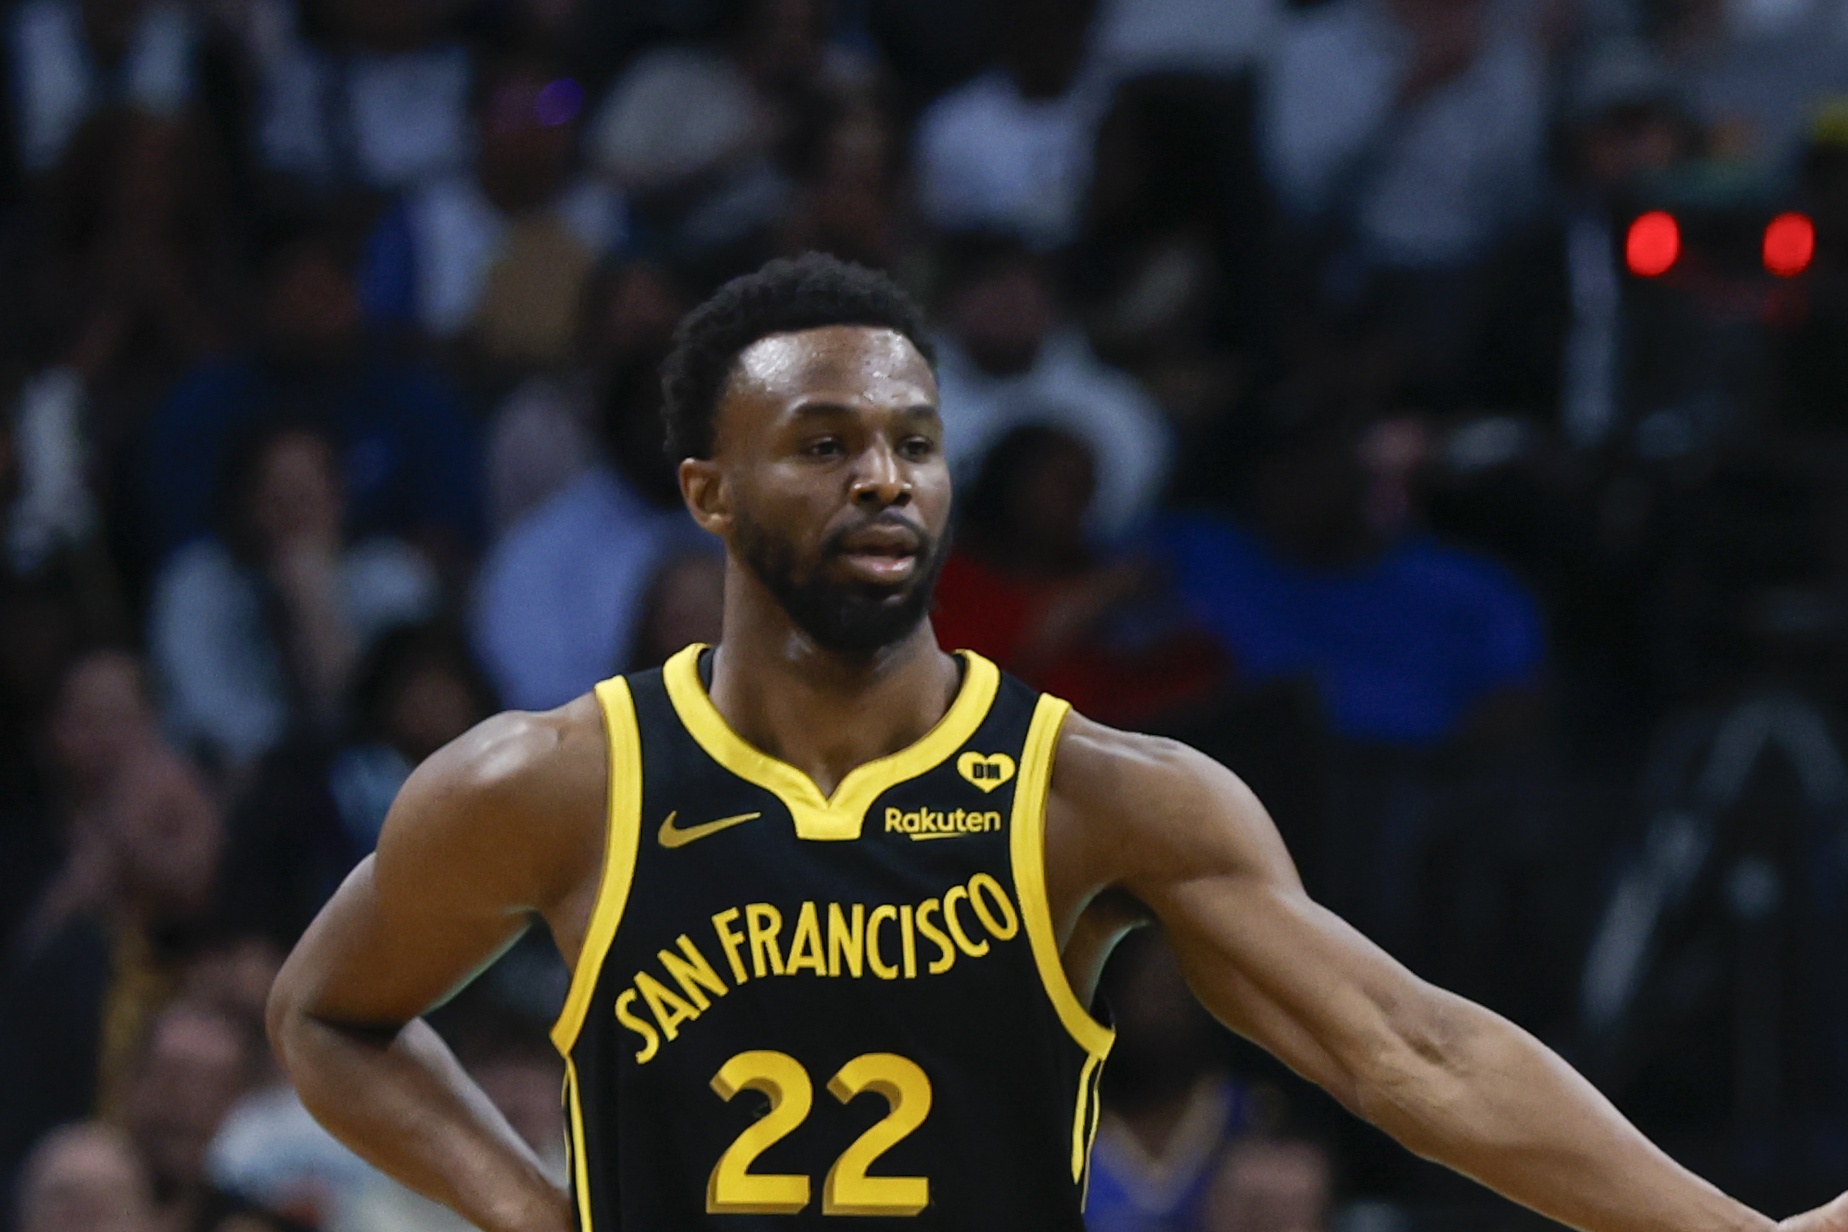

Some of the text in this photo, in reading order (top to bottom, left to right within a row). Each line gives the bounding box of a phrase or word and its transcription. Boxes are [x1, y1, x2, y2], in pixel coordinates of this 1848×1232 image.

[885, 806, 1001, 834] Rakuten
[615, 873, 1021, 1064] SAN FRANCISCO
[706, 1050, 932, 1216] 22
